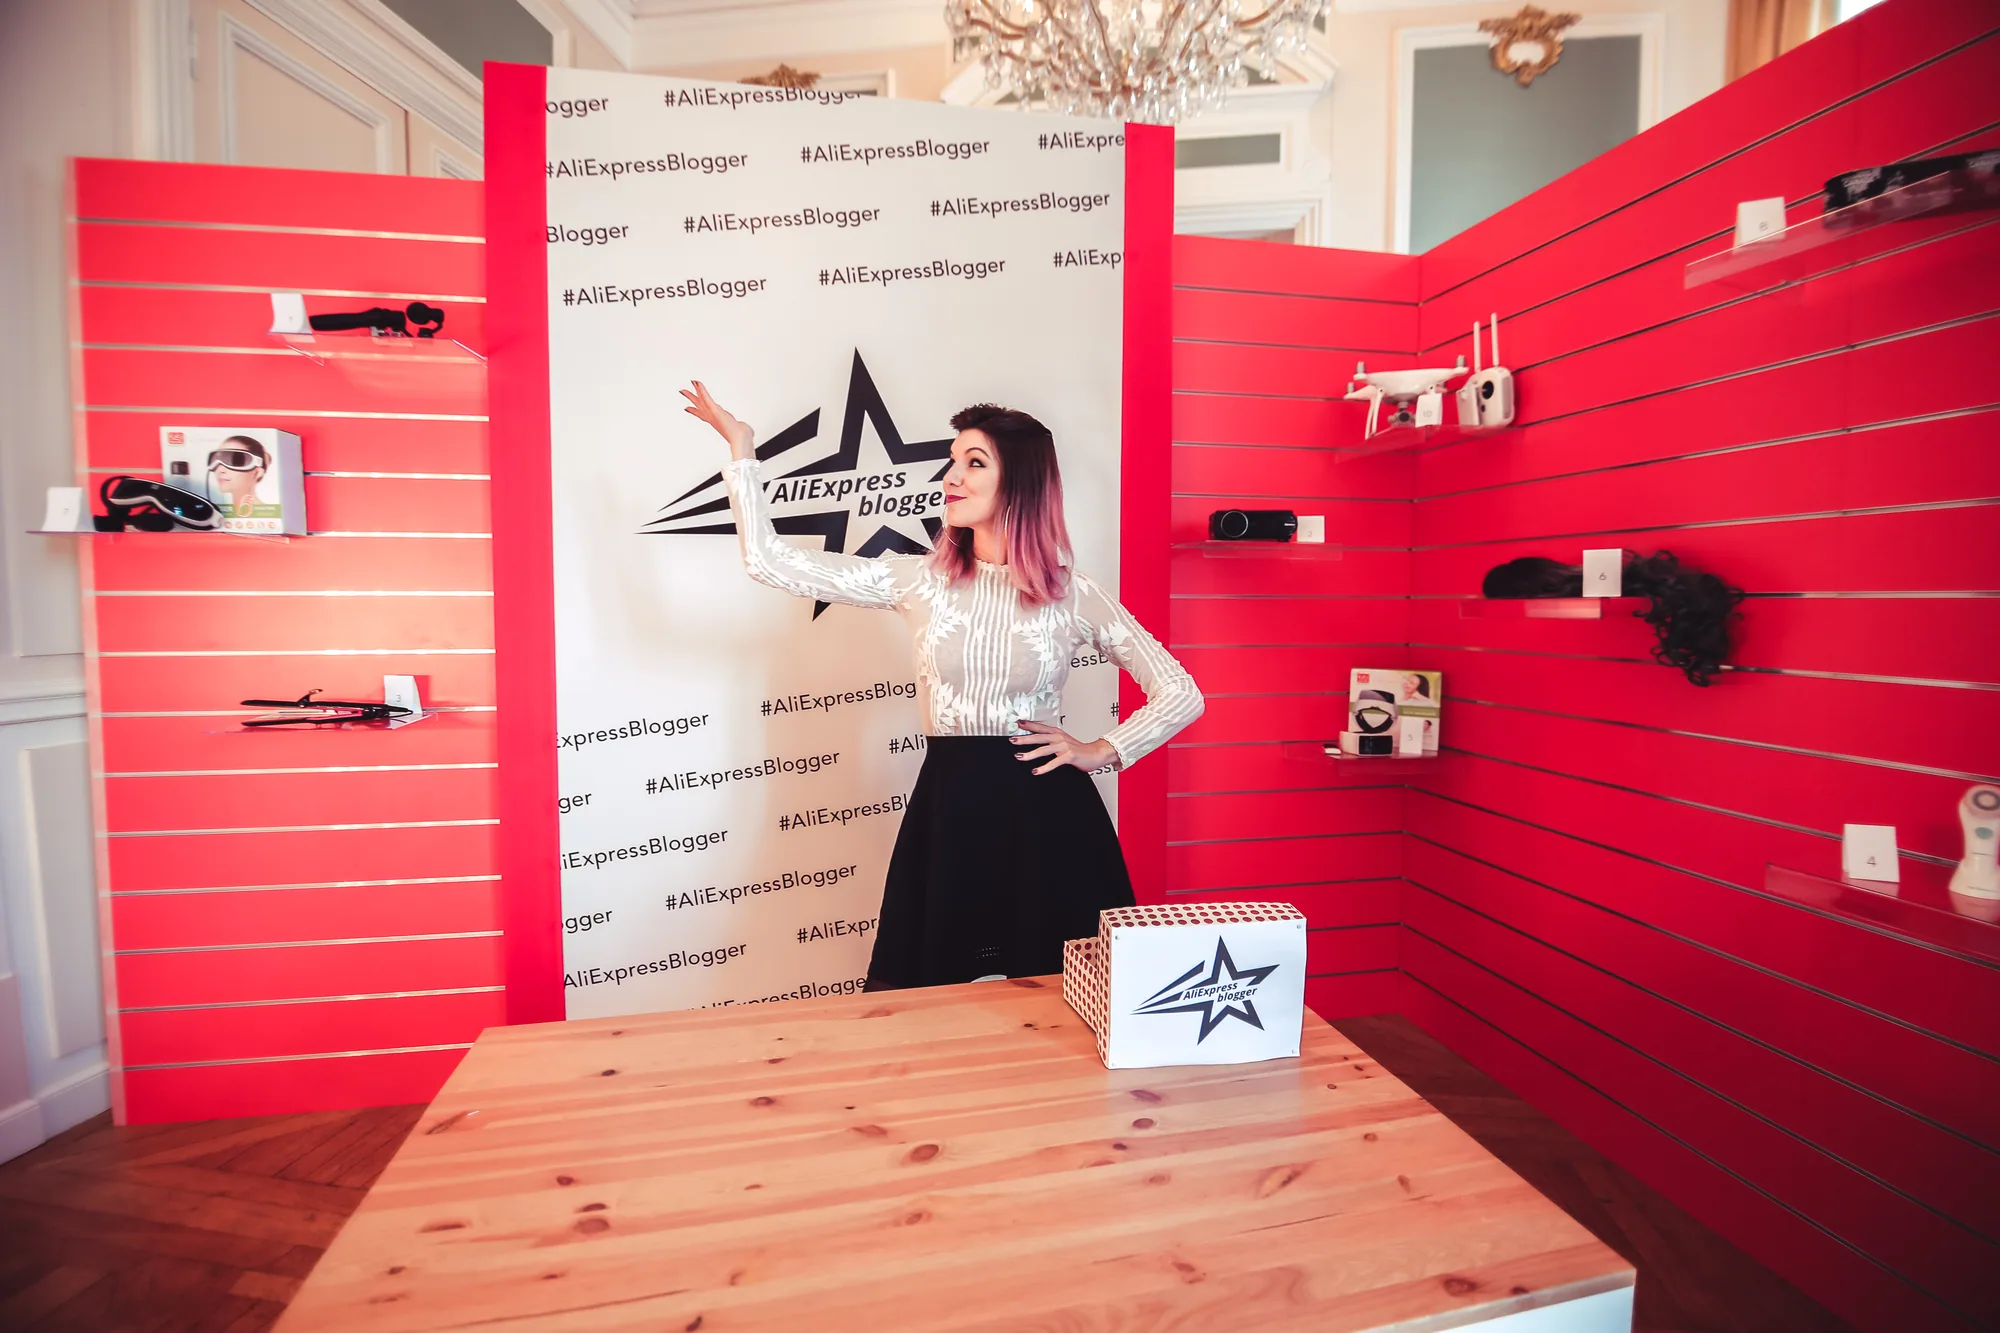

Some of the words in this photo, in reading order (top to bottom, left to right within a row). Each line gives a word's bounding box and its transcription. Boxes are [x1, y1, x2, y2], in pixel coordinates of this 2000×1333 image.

[546, 99, 609, 118] ogger
[801, 139, 989, 165] #AliExpressBlogger
[1038, 132, 1124, 152] #AliExpre
[546, 225, 629, 245] Blogger
[684, 207, 880, 234] #AliExpressBlogger
[930, 192, 1110, 218] #AliExpressBlogger
[563, 278, 767, 307] #AliExpressBlogger
[819, 259, 1005, 287] #AliExpressBlogger
[1053, 249, 1123, 270] #AliExp
[771, 471, 907, 504] AliExpress
[1599, 572, 1607, 581] 6
[556, 713, 709, 751] xpressBlogger
[761, 681, 917, 716] #AliExpressBlog
[646, 753, 840, 794] #AliExpressBlogger
[889, 734, 925, 754] #Ali
[560, 829, 728, 870] iExpressBlogger
[779, 794, 908, 831] #AliExpressBl
[1866, 856, 1877, 867] 4
[562, 910, 613, 934] gger
[666, 865, 857, 911] #AliExpressBlogger
[797, 917, 877, 943] #AliExpr
[1183, 983, 1238, 1000] AliExpress
[1217, 988, 1258, 1003] blogger
